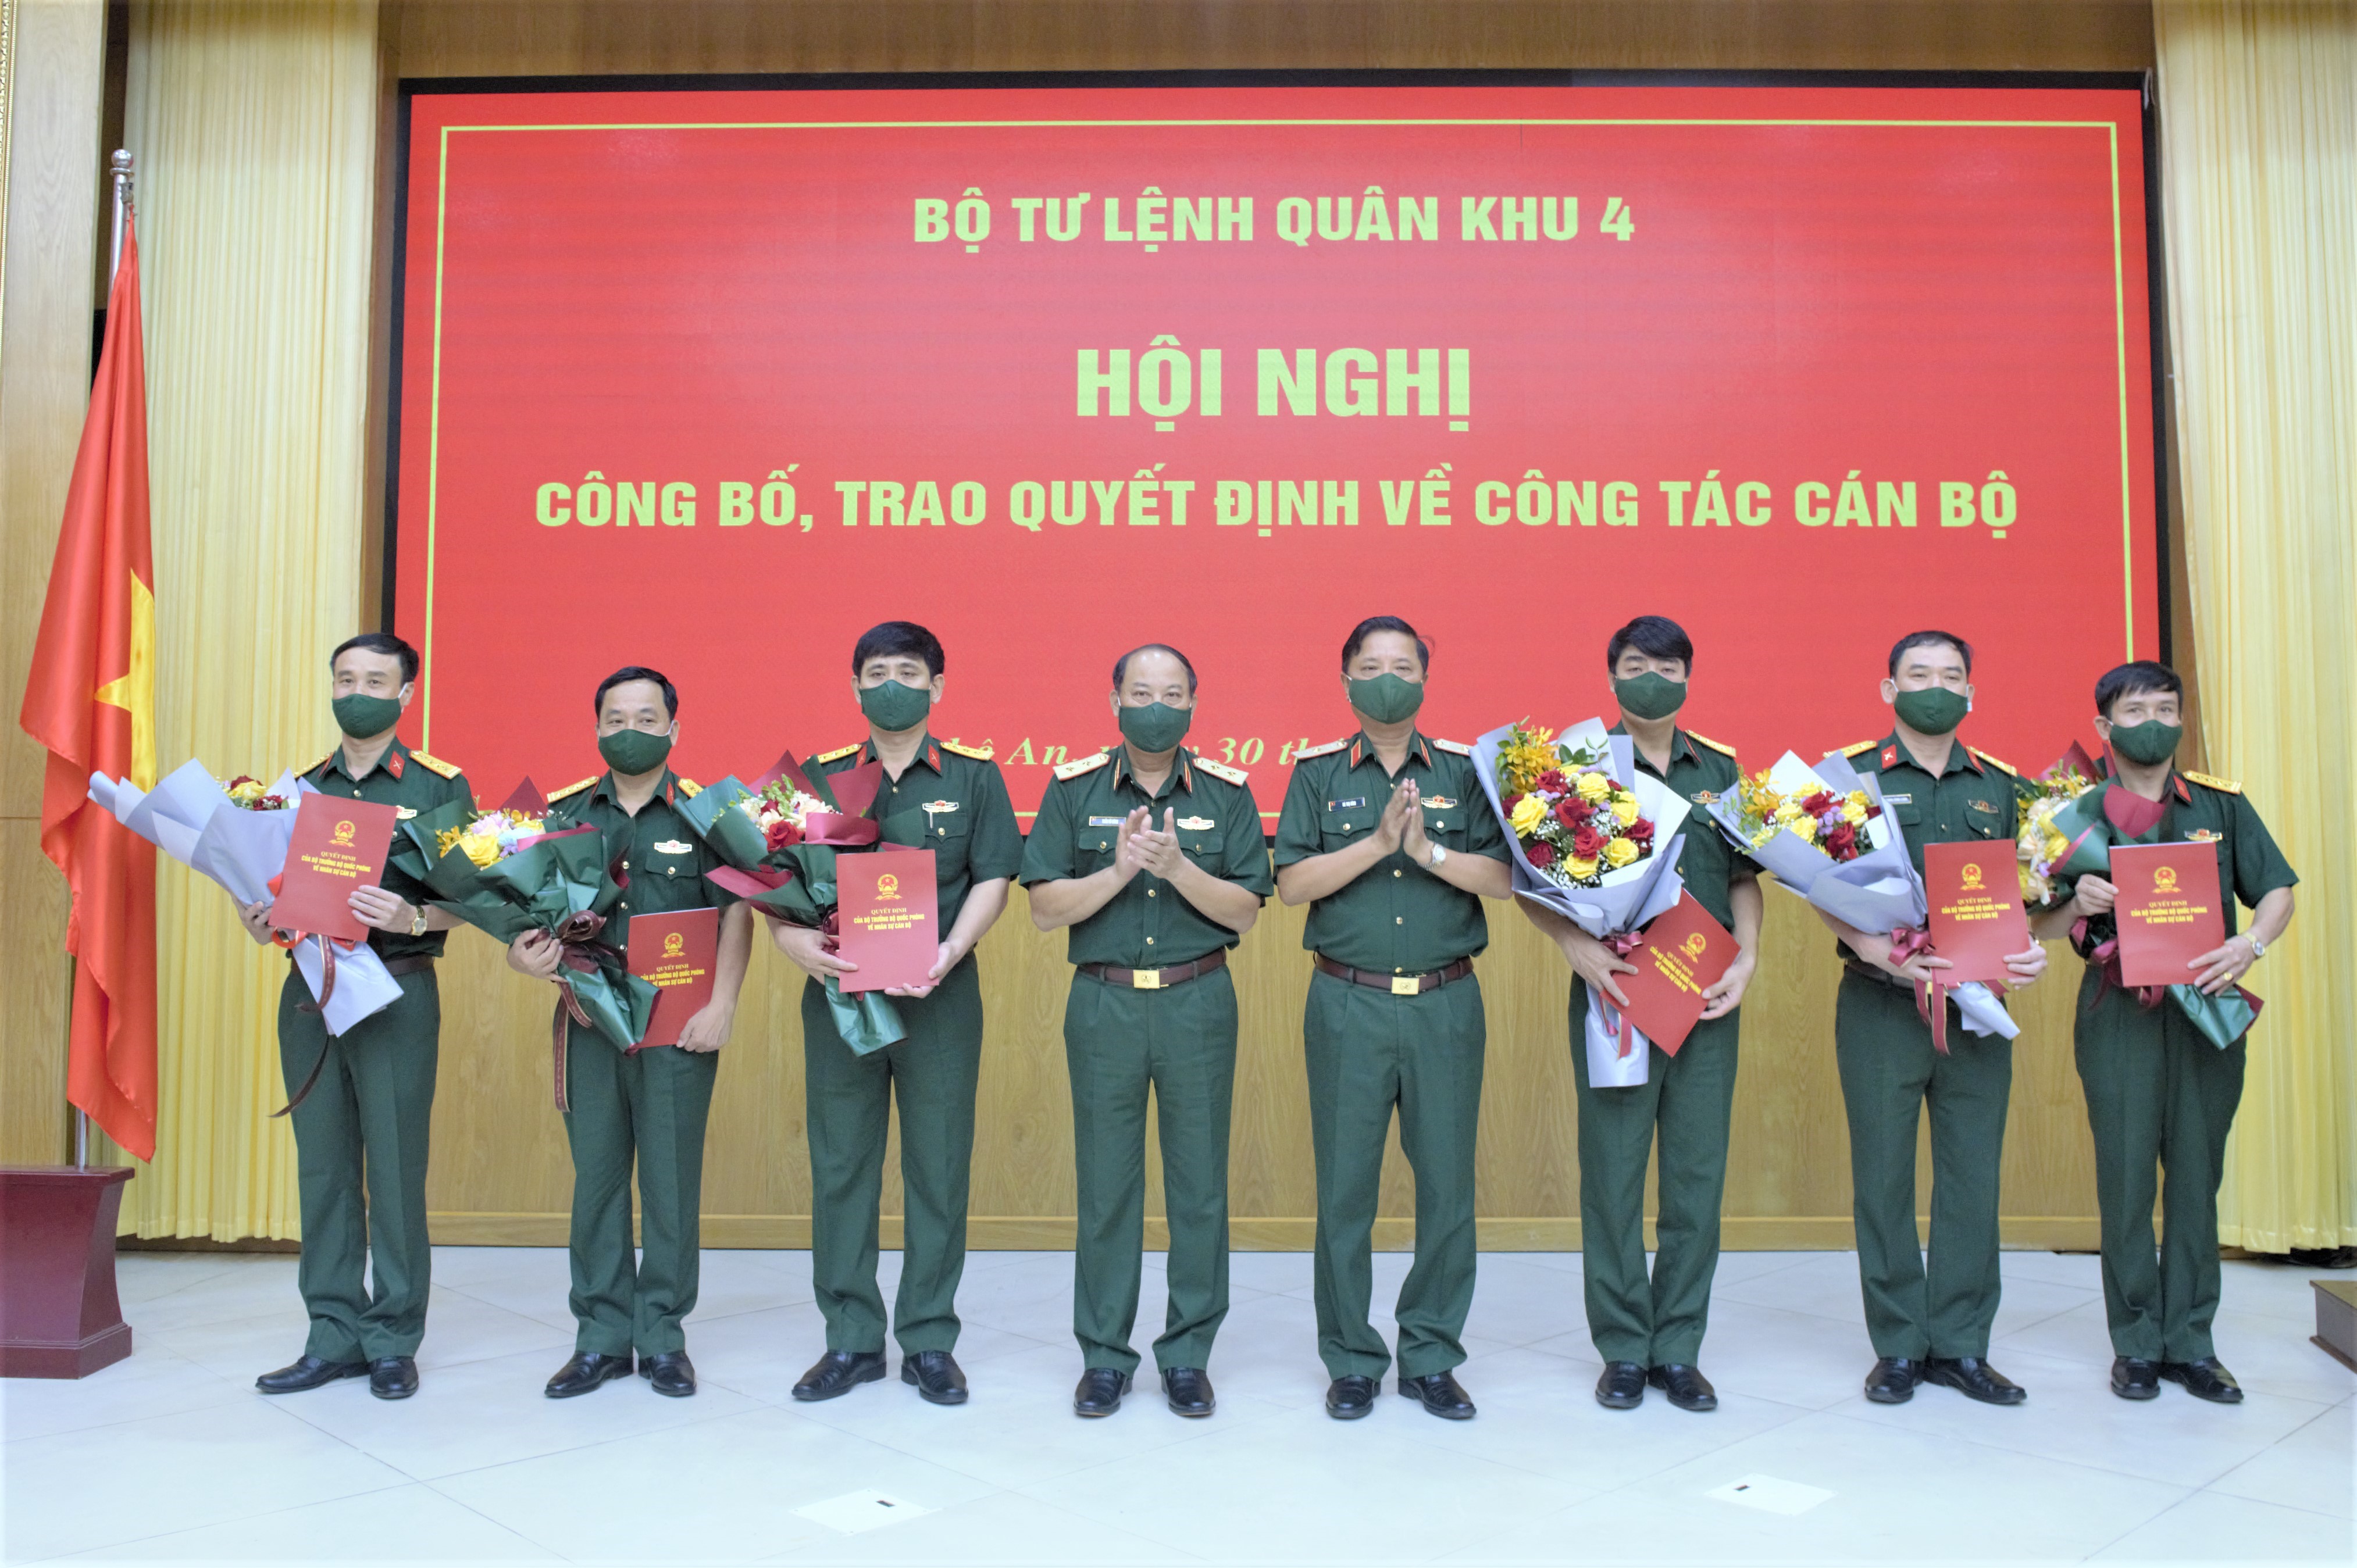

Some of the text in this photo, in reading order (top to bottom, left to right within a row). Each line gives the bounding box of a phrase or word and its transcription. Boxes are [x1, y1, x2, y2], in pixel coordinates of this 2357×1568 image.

[914, 185, 1635, 253] BỘ TƯ LỆNH QUÂN KHU 4
[1076, 334, 1470, 432] HỘI NGHỊ
[536, 462, 2016, 538] CÔNG BỐ, TRAO QUYẾT ĐỊNH VỀ CÔNG TÁC CÁN BỘ
[1218, 737, 1264, 765] 30
